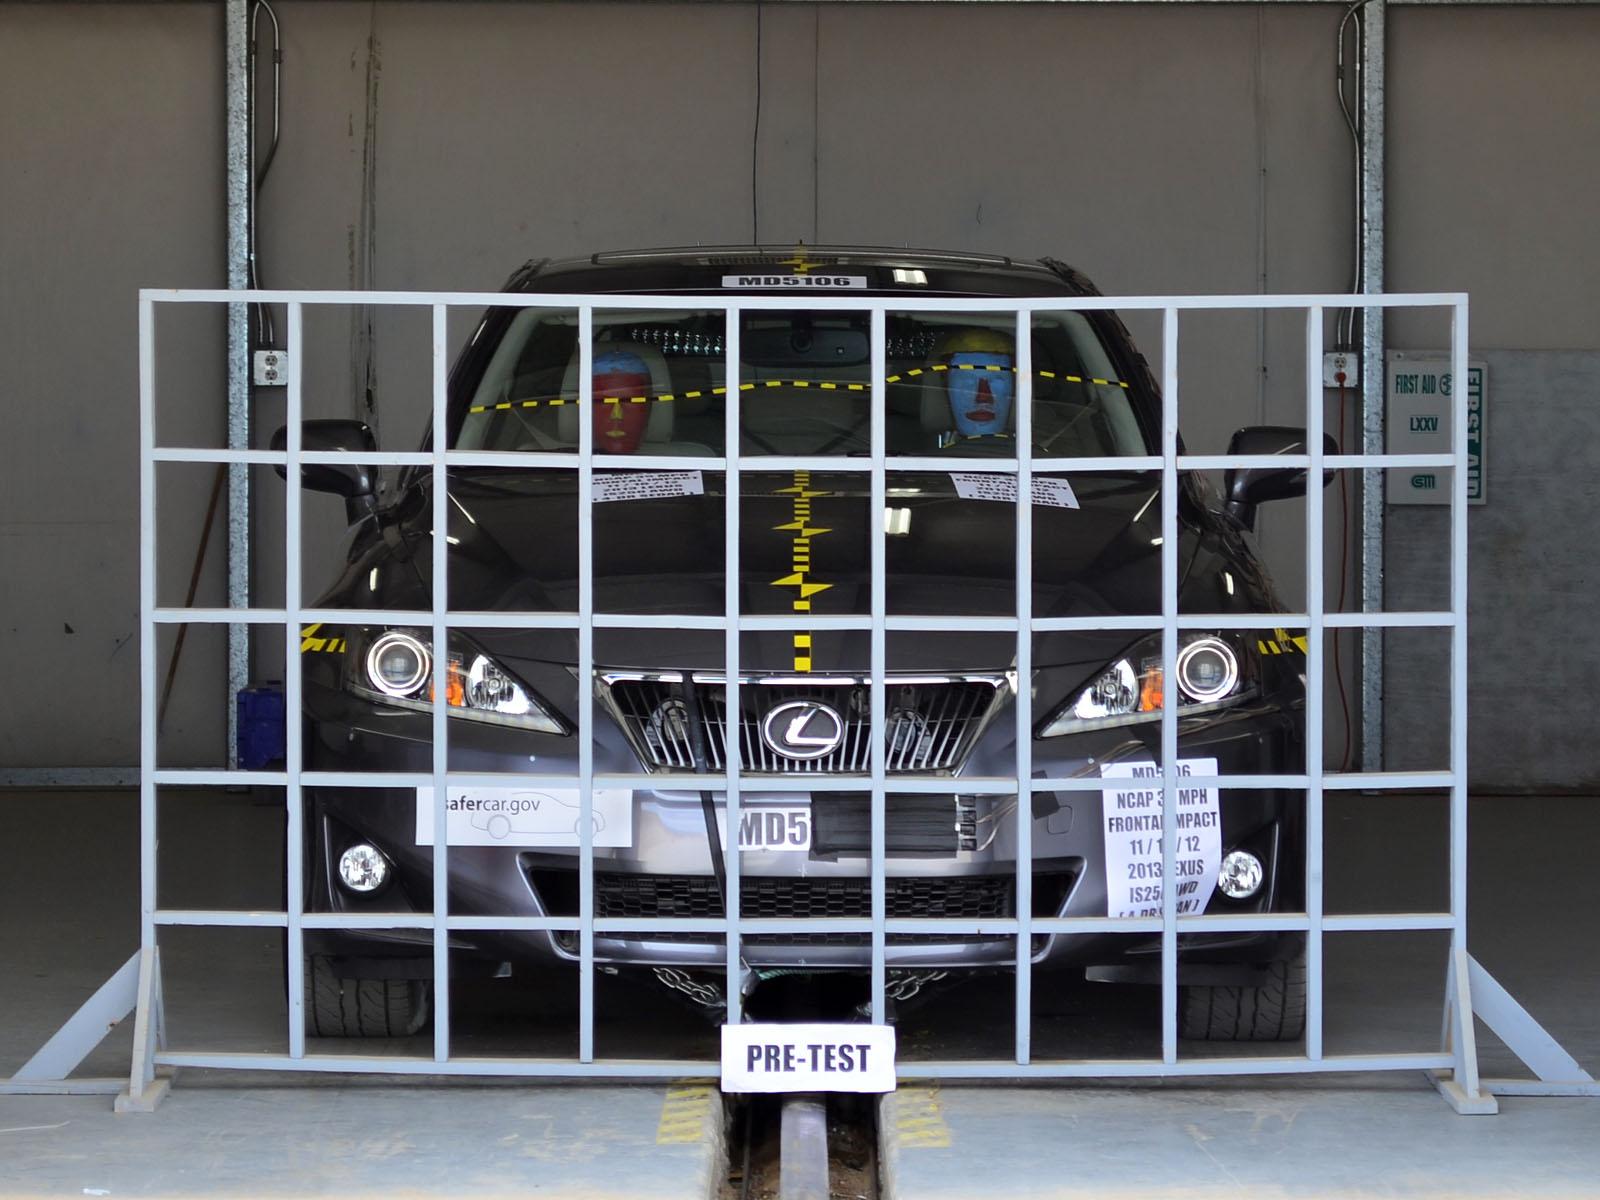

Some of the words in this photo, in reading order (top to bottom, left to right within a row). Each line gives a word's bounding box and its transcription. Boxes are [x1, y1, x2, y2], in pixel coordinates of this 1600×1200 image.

[738, 277, 850, 286] MD5106
[1395, 374, 1419, 394] FIRST
[1422, 374, 1436, 394] AID
[1410, 417, 1438, 431] LXXV
[1117, 791, 1154, 809] NCAP
[1178, 788, 1208, 806] MPH
[1176, 811, 1218, 830] MPACT
[1128, 861, 1162, 879] 2013
[1176, 859, 1204, 877] EXUS
[1129, 885, 1163, 903] IS25
[1176, 880, 1199, 897] WD
[747, 1044, 871, 1072] PRE-TEST
